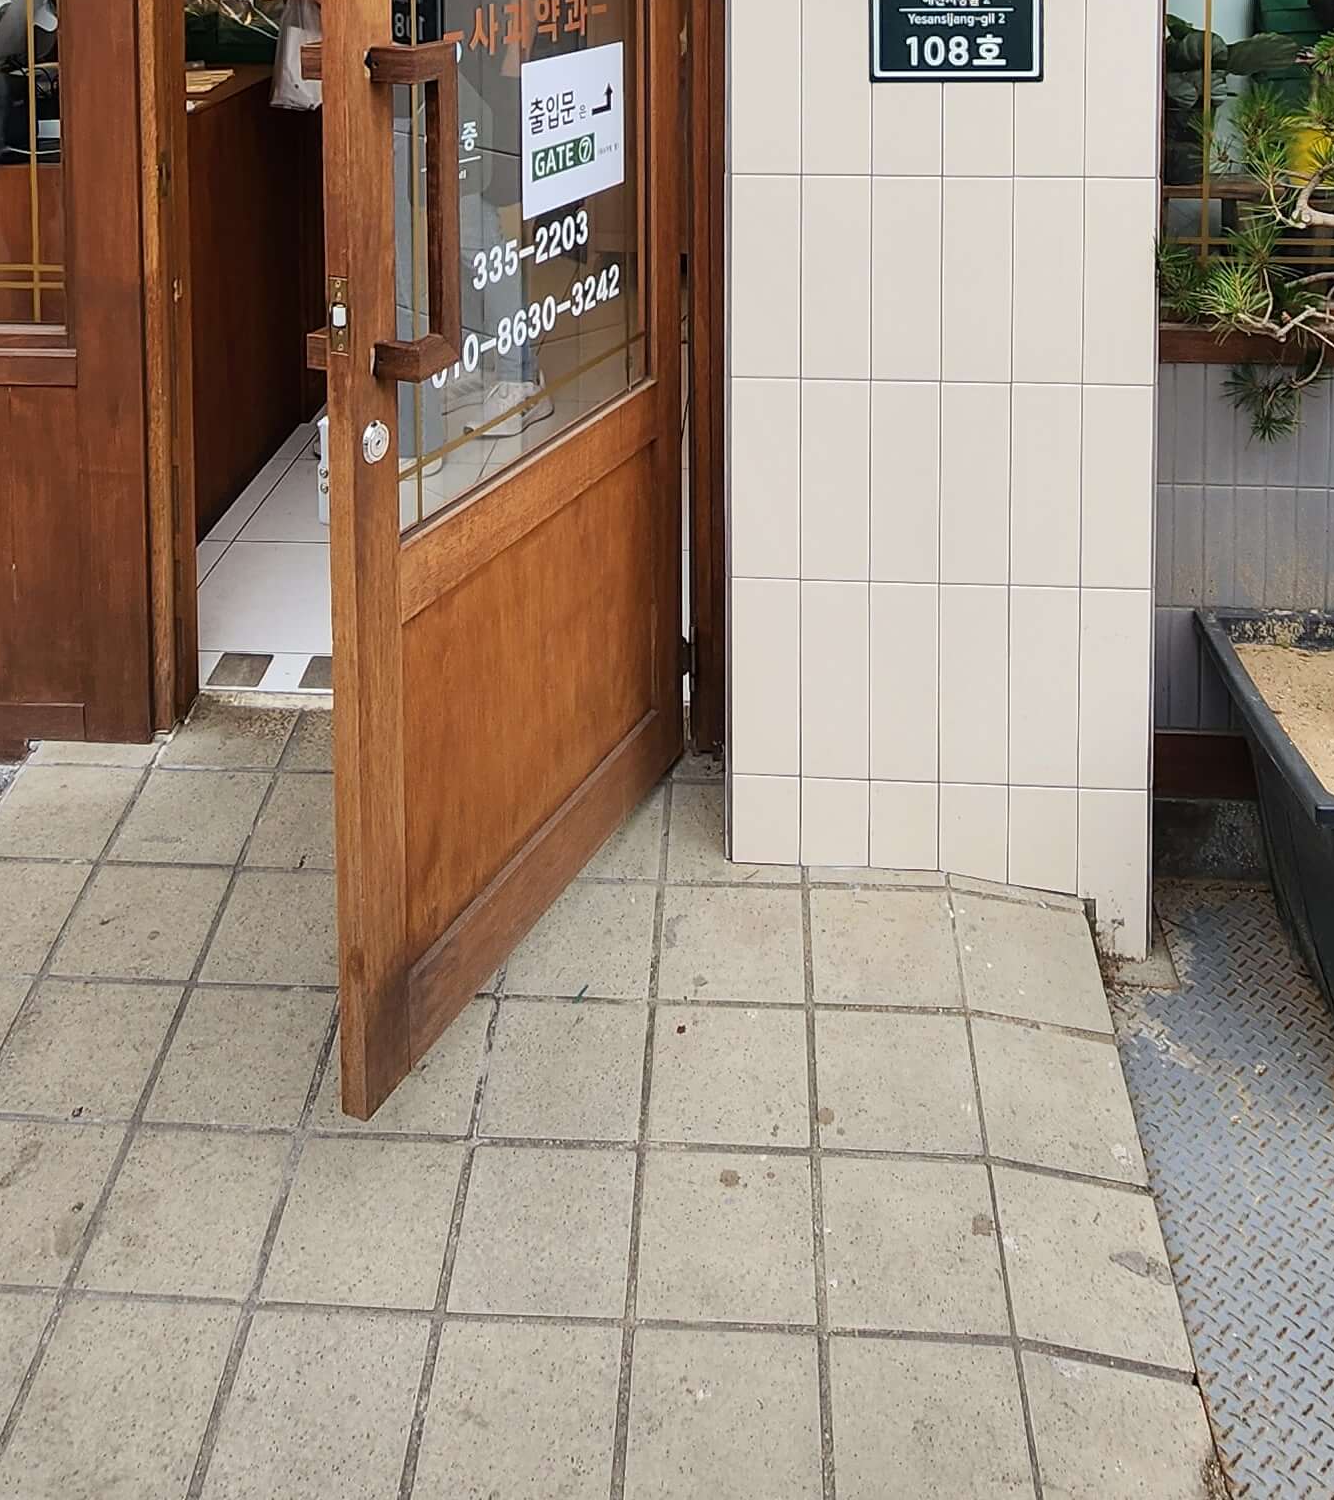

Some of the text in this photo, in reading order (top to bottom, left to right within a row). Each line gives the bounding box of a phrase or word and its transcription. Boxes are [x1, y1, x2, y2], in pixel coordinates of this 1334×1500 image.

[907, 12, 1006, 27] Yesansijang-gil 2
[905, 33, 1007, 67] 108호
[534, 142, 575, 178] GATE
[473, 210, 588, 290] 335-2203
